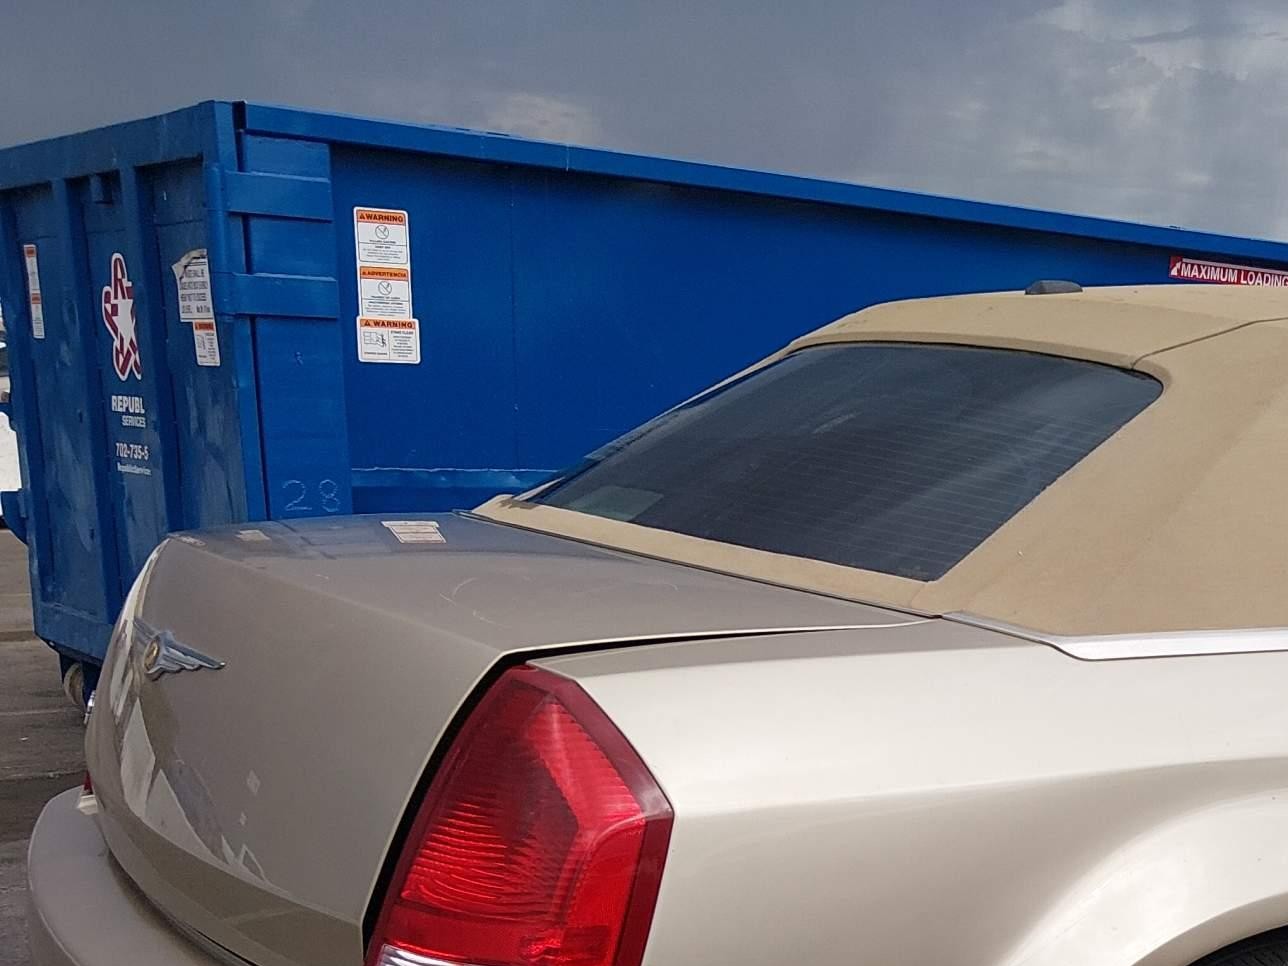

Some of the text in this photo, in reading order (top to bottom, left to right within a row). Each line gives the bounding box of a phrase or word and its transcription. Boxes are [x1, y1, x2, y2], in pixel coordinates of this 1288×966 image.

[365, 213, 404, 222] WARNING
[1181, 263, 1238, 283] MAXIMUM
[122, 415, 146, 428] SERVICES
